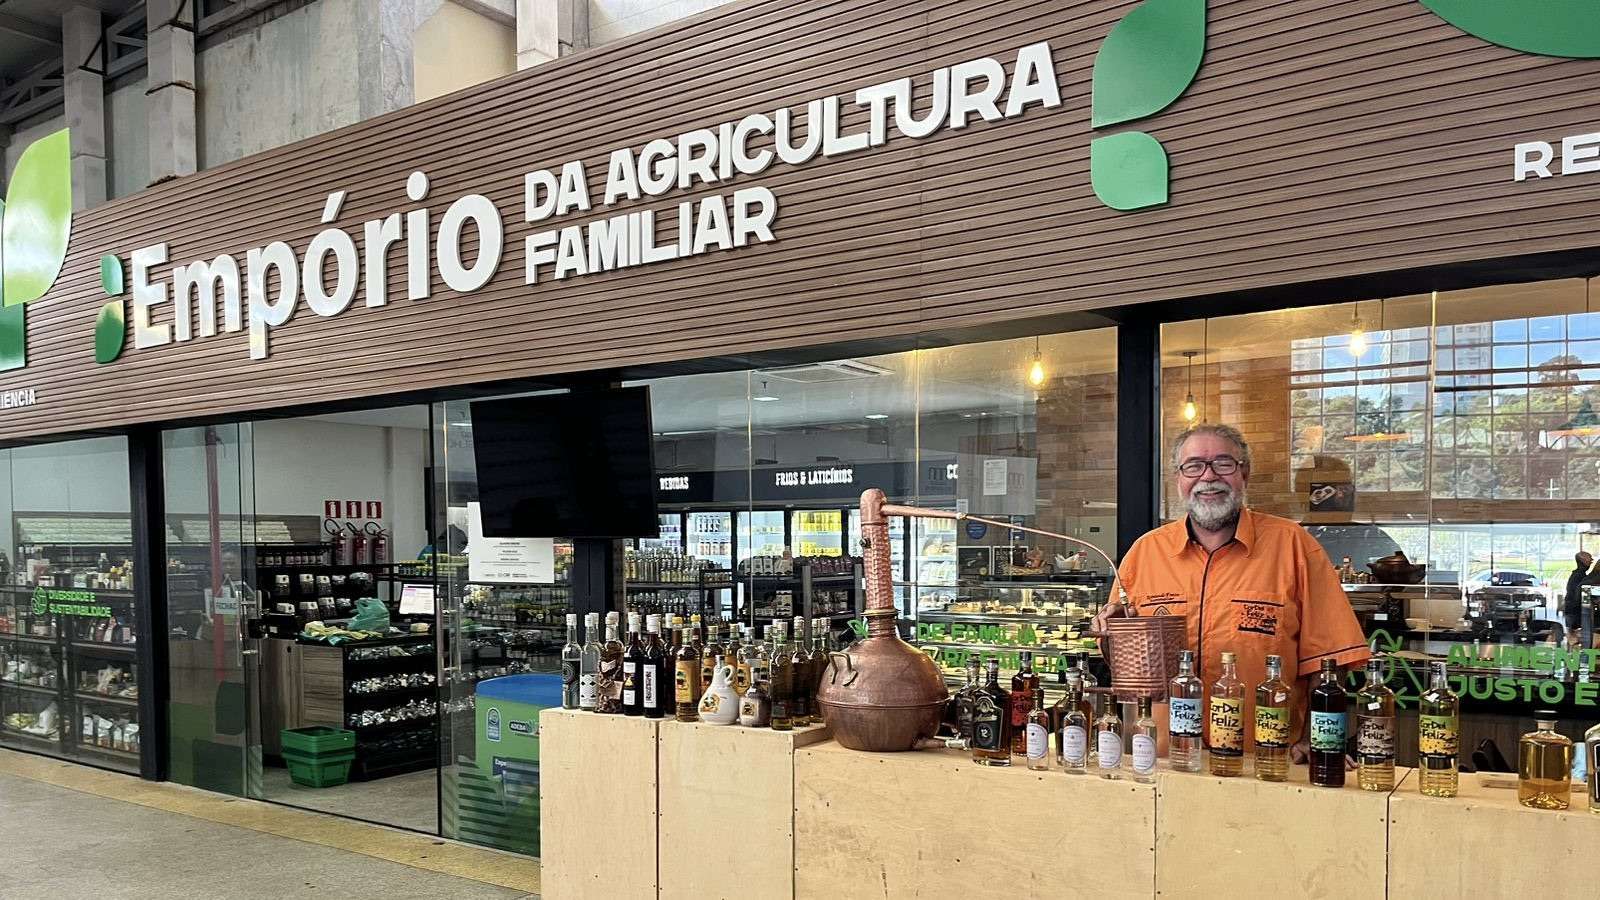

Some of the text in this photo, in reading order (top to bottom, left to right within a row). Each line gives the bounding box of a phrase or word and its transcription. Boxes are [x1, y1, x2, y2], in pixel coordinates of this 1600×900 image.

[524, 41, 1062, 222] DA AGRICULTURA
[1514, 132, 1600, 182] RE
[524, 186, 779, 285] FAMILIAR
[132, 171, 504, 360] Empório
[659, 476, 690, 490] BEBIDAS
[775, 467, 853, 486] FRIOS & LATICÍNIOS
[918, 622, 946, 641] DE
[1447, 675, 1565, 705] JUSTO
[1175, 710, 1196, 720] Feliz
[1211, 712, 1240, 727] Feliz
[1257, 719, 1279, 729] Feliz
[1422, 728, 1446, 739] Feliz
